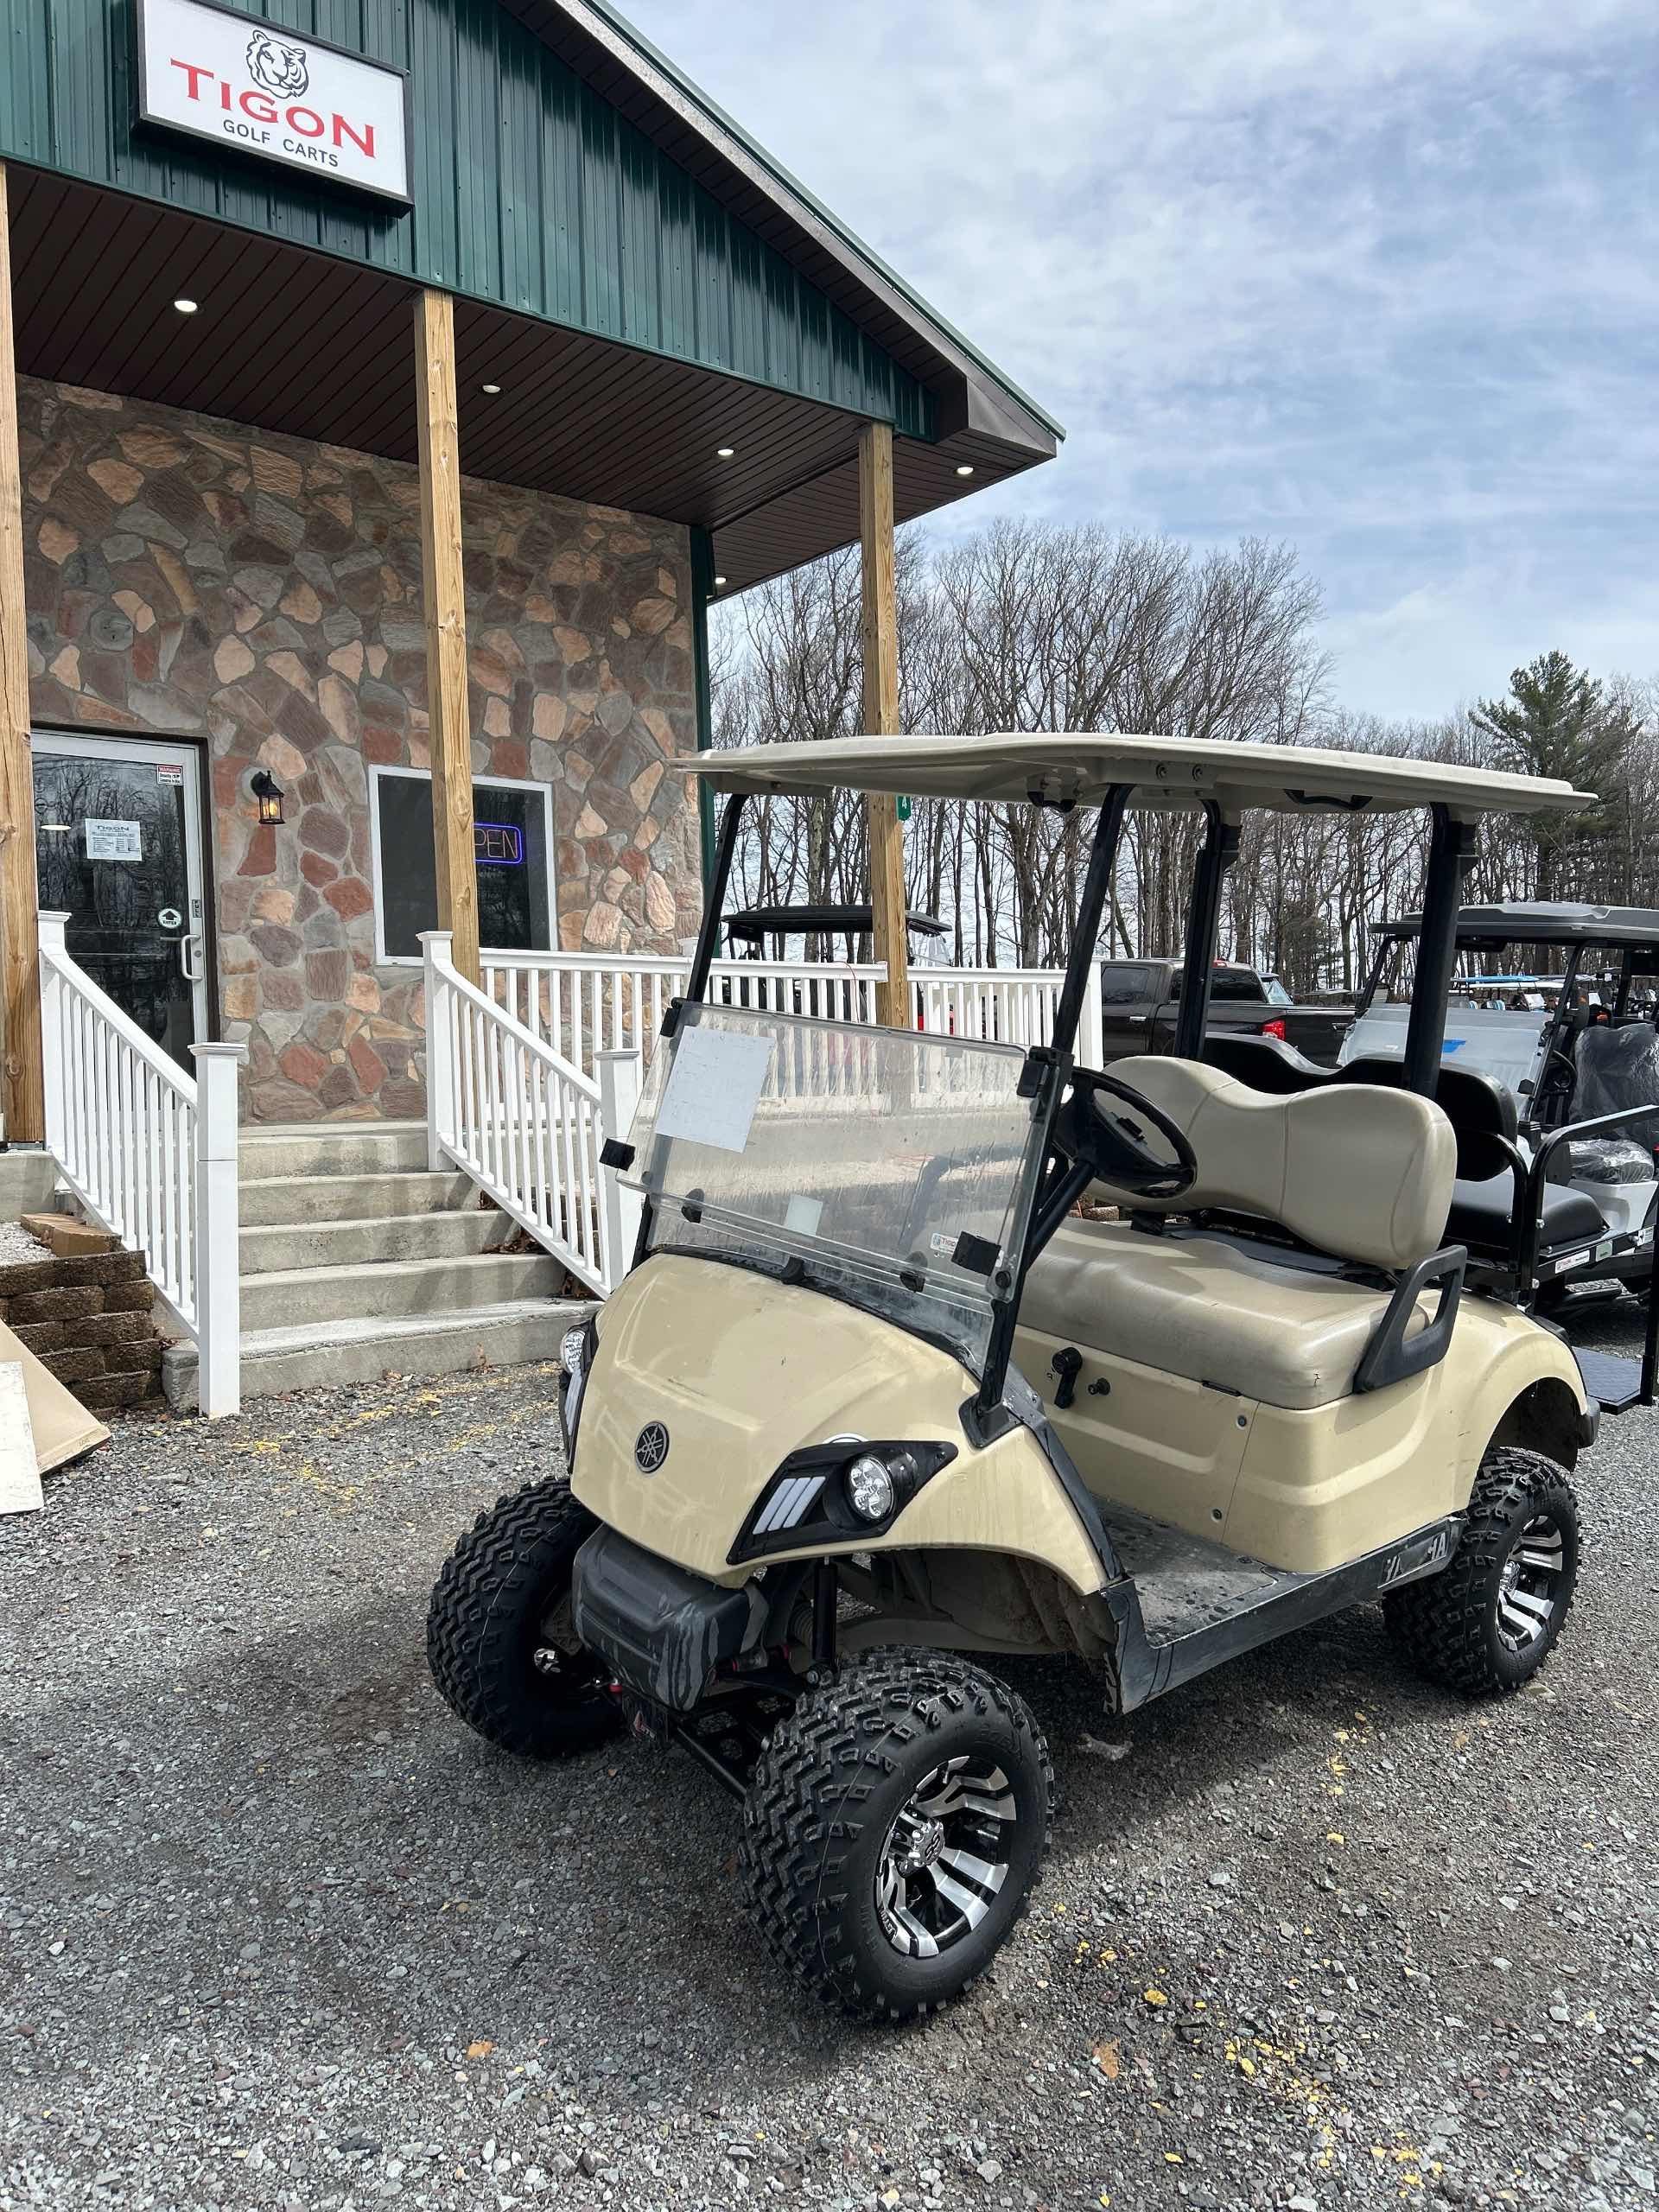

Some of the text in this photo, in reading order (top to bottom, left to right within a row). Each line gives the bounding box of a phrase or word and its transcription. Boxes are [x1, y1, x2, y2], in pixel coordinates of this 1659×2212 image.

[170, 57, 376, 159] TIGON
[223, 118, 339, 168] GOLF CARTS
[474, 828, 518, 859] PEN
